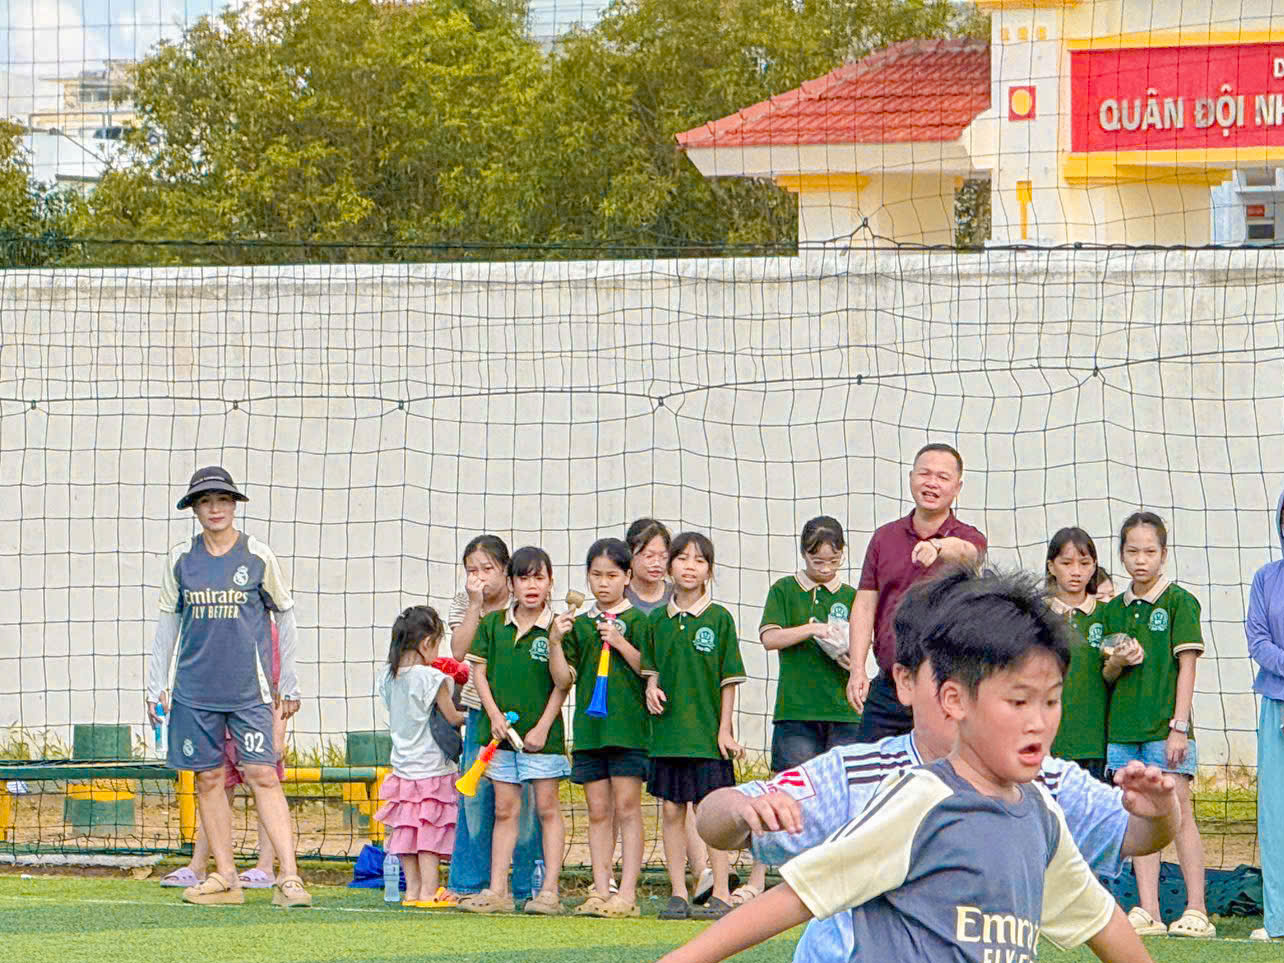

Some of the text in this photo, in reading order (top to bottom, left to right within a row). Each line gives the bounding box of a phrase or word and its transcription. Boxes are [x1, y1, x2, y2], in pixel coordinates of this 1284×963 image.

[1099, 87, 1184, 131] QUÂN
[1194, 83, 1245, 137] ĐỘI
[184, 587, 248, 605] Emirates
[208, 605, 240, 619] BETTER
[245, 732, 264, 752] 02
